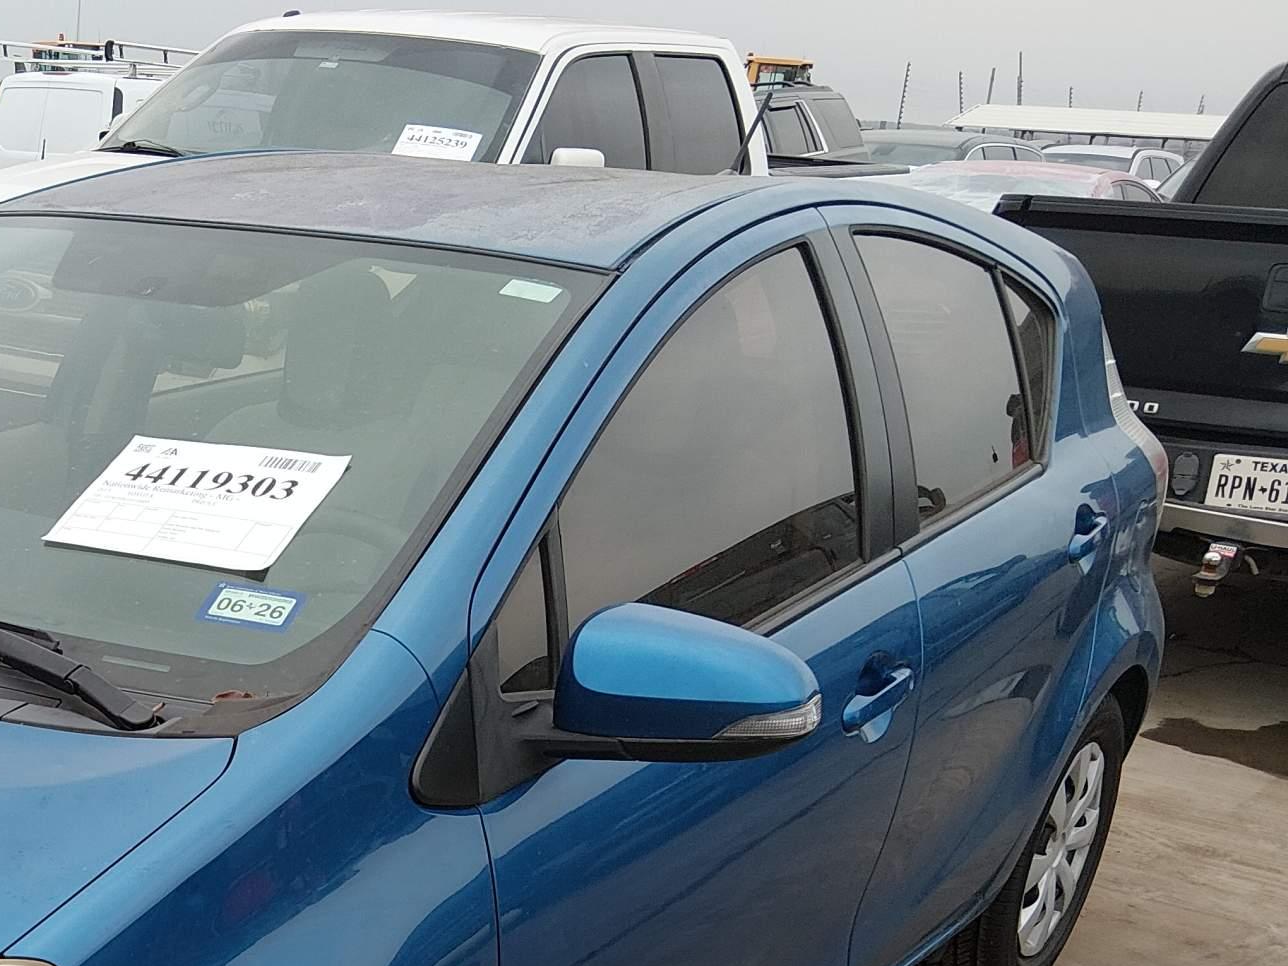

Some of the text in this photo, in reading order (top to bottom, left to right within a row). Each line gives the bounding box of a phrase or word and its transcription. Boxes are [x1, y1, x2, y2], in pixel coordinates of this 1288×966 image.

[407, 134, 468, 149] 44125239
[1252, 460, 1288, 474] TEXA
[125, 463, 299, 501] 44119303
[1214, 473, 1258, 502] RPN
[216, 597, 247, 613] 06
[253, 602, 286, 620] 26
